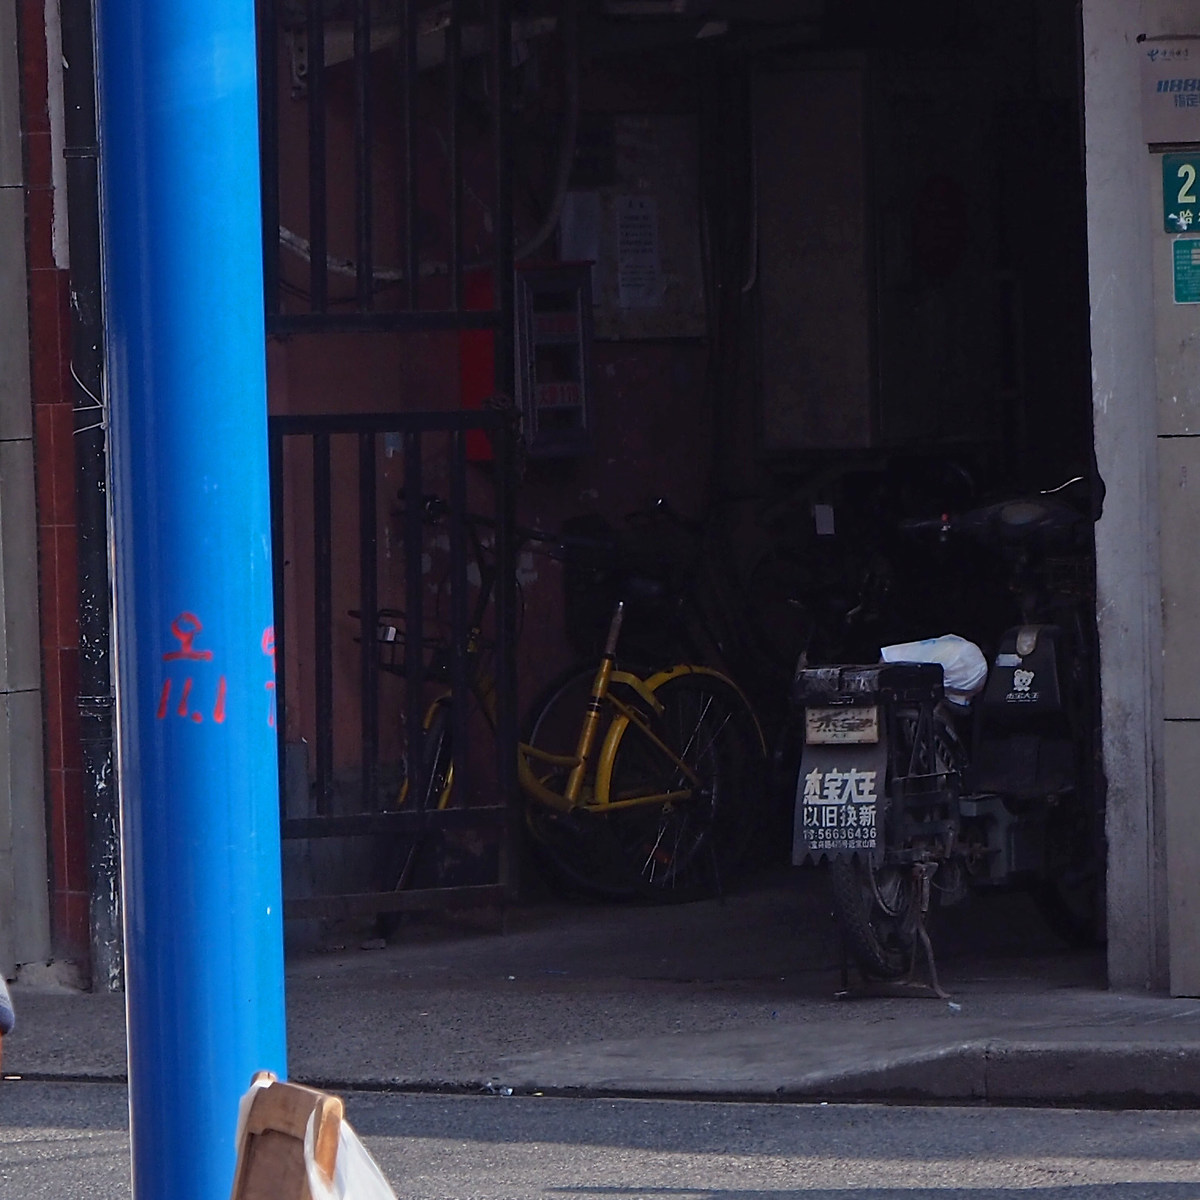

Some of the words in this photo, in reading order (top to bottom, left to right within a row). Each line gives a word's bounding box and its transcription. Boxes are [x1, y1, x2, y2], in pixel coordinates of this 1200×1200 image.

[1174, 93, 1200, 107] 指定
[1179, 209, 1200, 224] 哈
[803, 805, 877, 828] 以旧换新
[818, 827, 877, 840] 56636436
